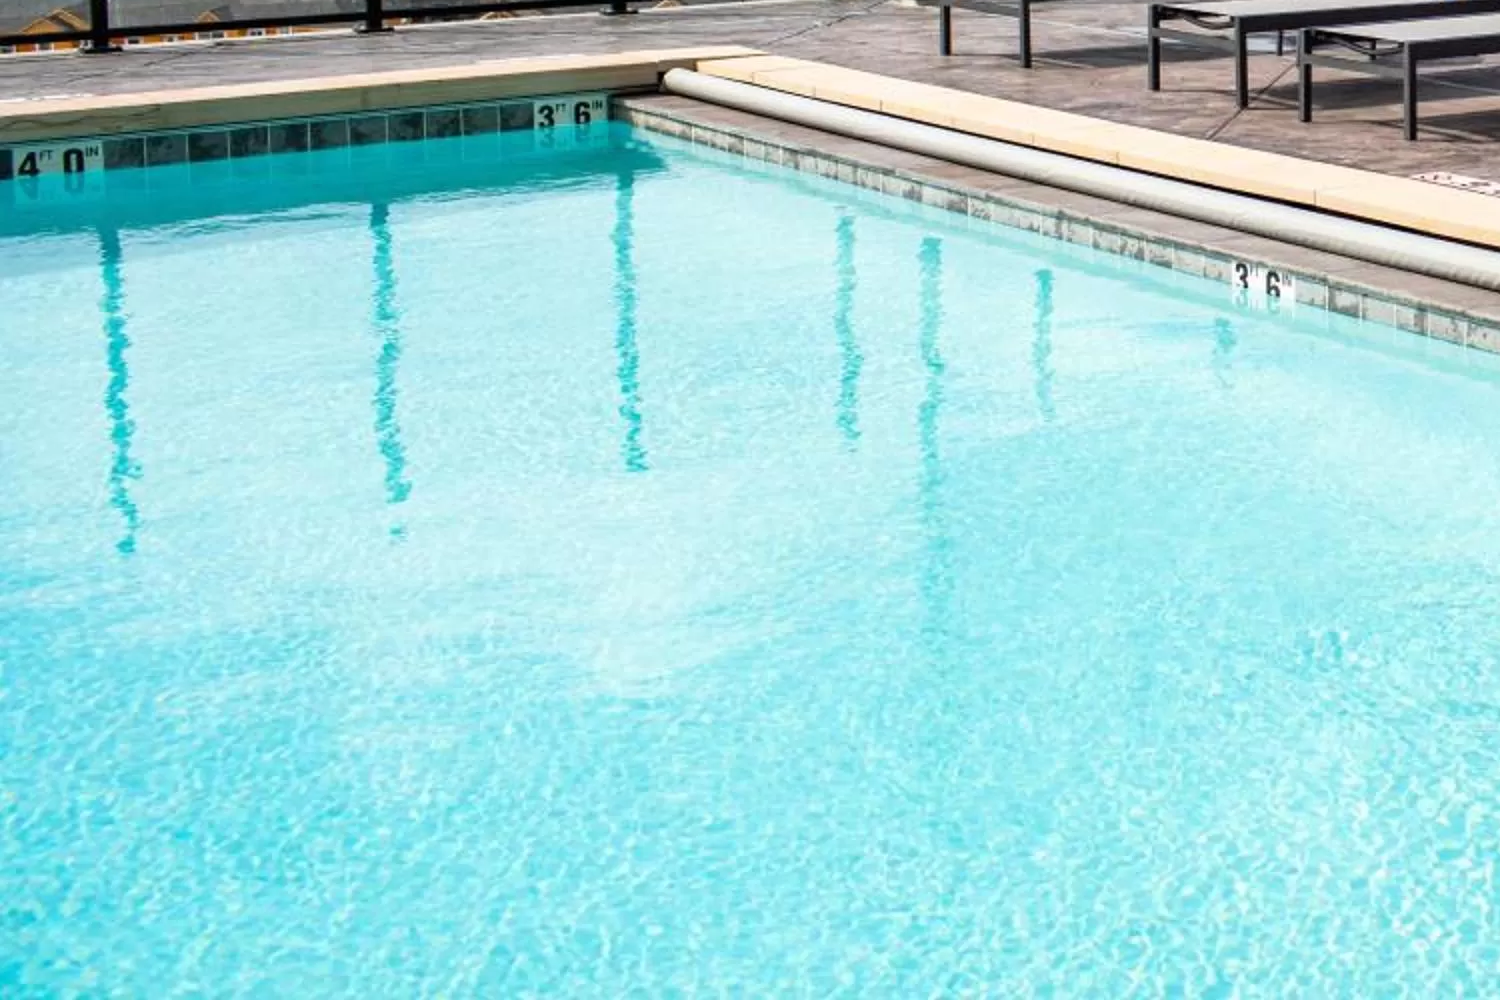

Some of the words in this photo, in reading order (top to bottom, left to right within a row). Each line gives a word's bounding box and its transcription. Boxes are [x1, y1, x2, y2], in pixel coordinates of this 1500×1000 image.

[539, 105, 555, 127] 3
[575, 101, 591, 124] 6
[18, 151, 40, 175] 4
[1235, 263, 1249, 288] 3
[1266, 270, 1281, 297] 6
